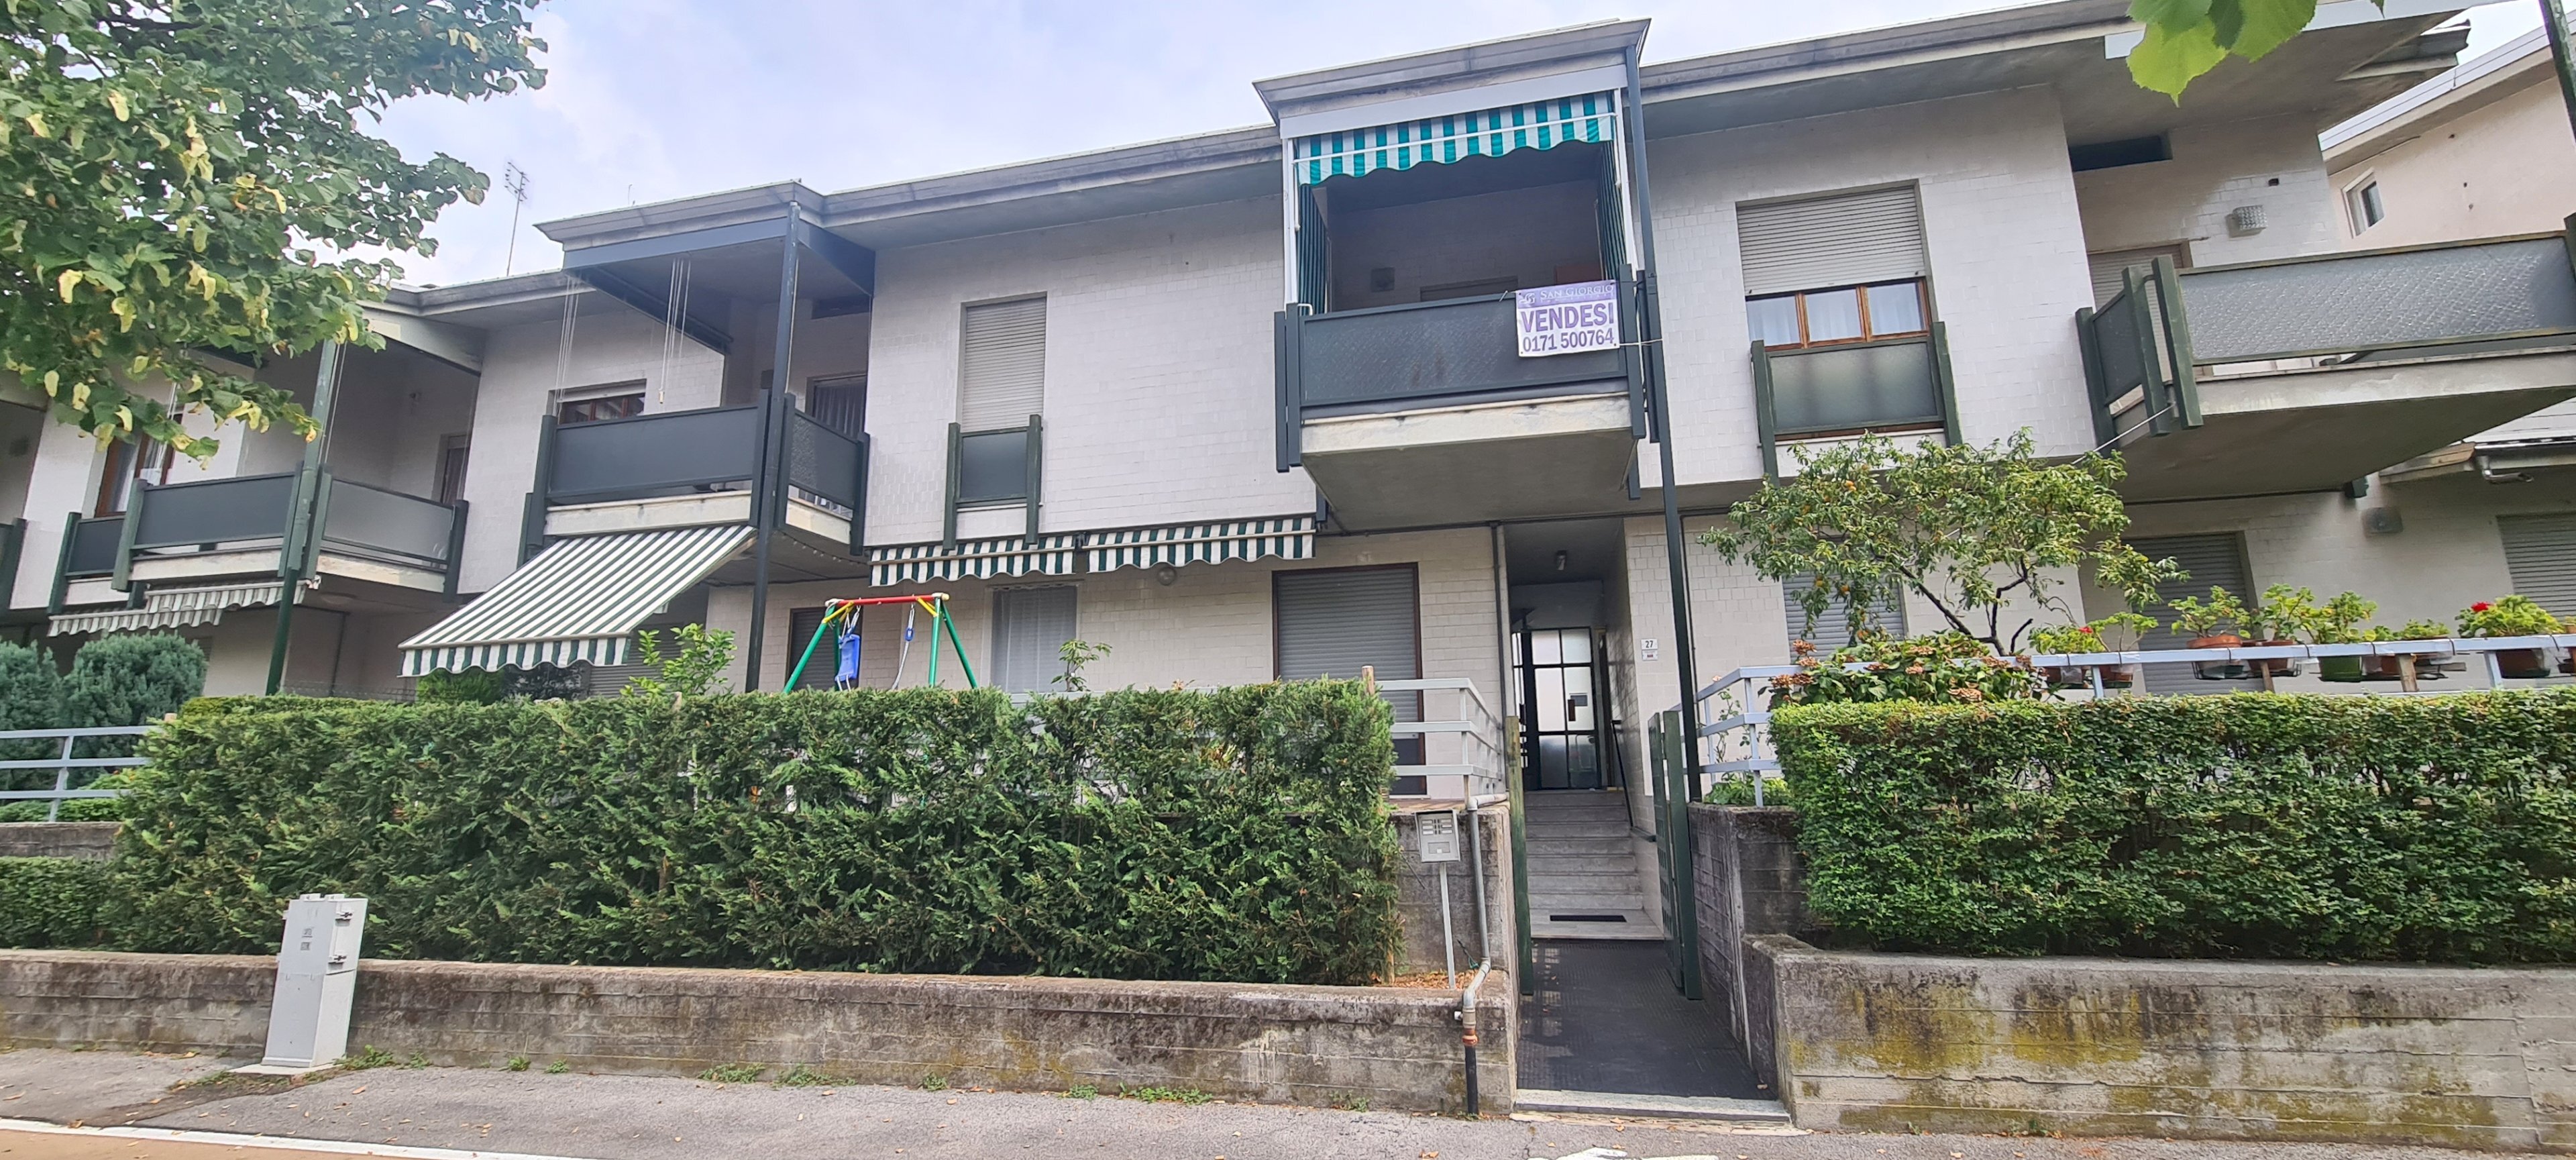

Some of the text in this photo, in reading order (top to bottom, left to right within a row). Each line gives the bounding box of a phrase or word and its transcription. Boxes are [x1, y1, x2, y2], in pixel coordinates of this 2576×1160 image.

[1540, 289, 1562, 299] SAN
[1566, 285, 1614, 297] GIORGIO
[1521, 303, 1614, 333] VENDESI
[1523, 328, 1614, 352] 0171 500764
[1645, 640, 1654, 648] 27
